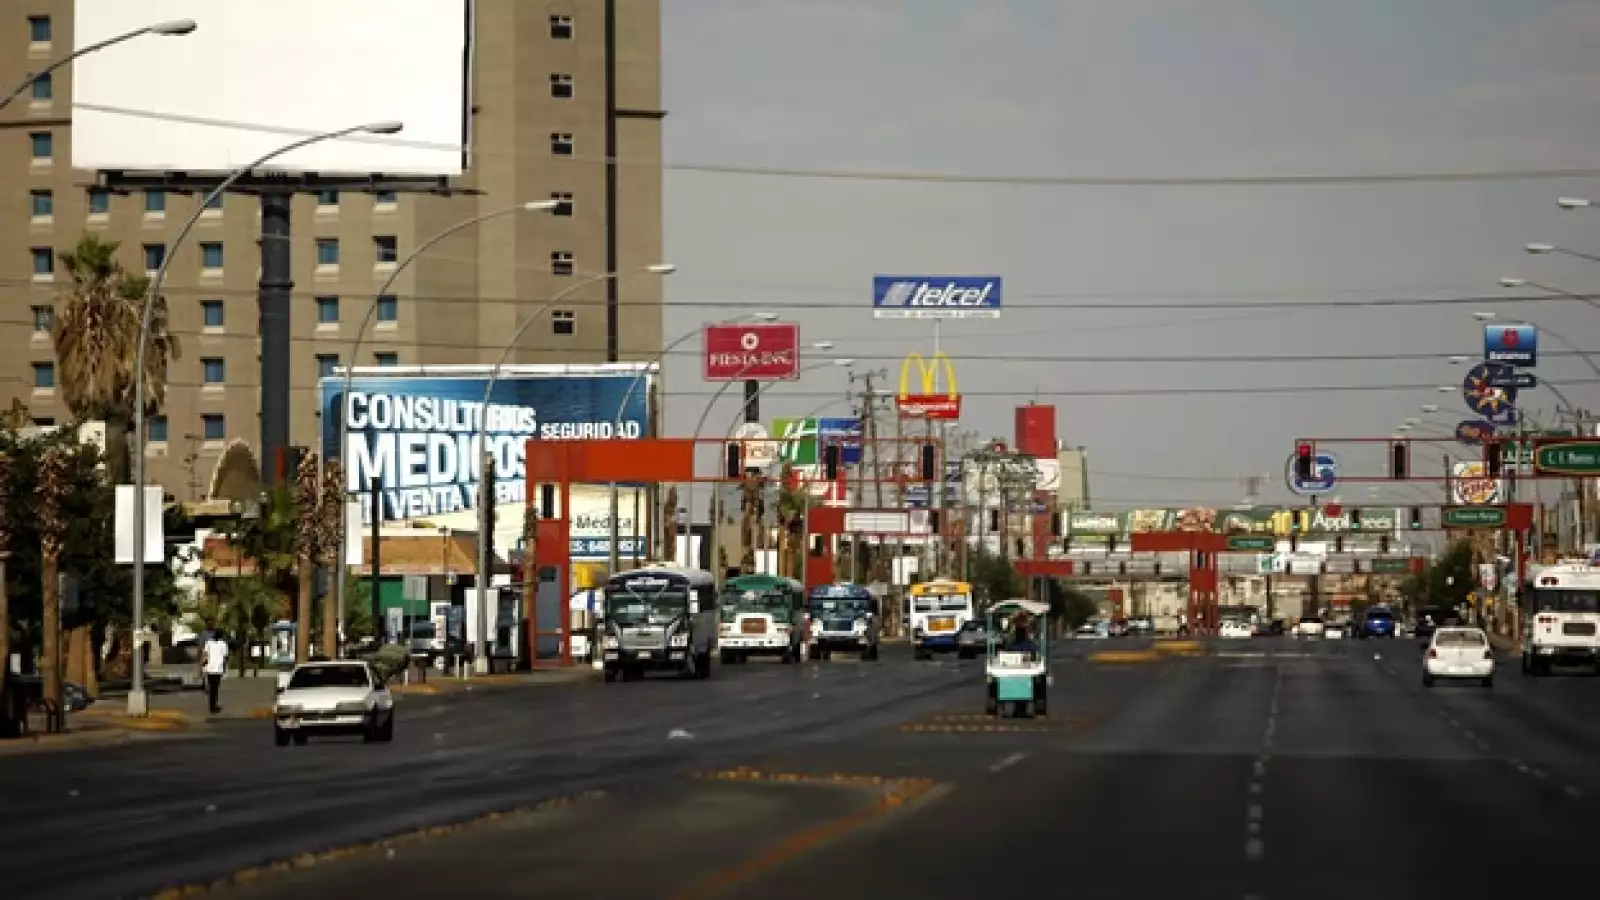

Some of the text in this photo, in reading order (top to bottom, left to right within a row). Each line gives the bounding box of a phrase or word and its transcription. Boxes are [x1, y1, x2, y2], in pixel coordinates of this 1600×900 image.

[909, 281, 995, 306] telcel
[708, 352, 757, 365] FIESTA
[387, 486, 464, 519] VENTA
